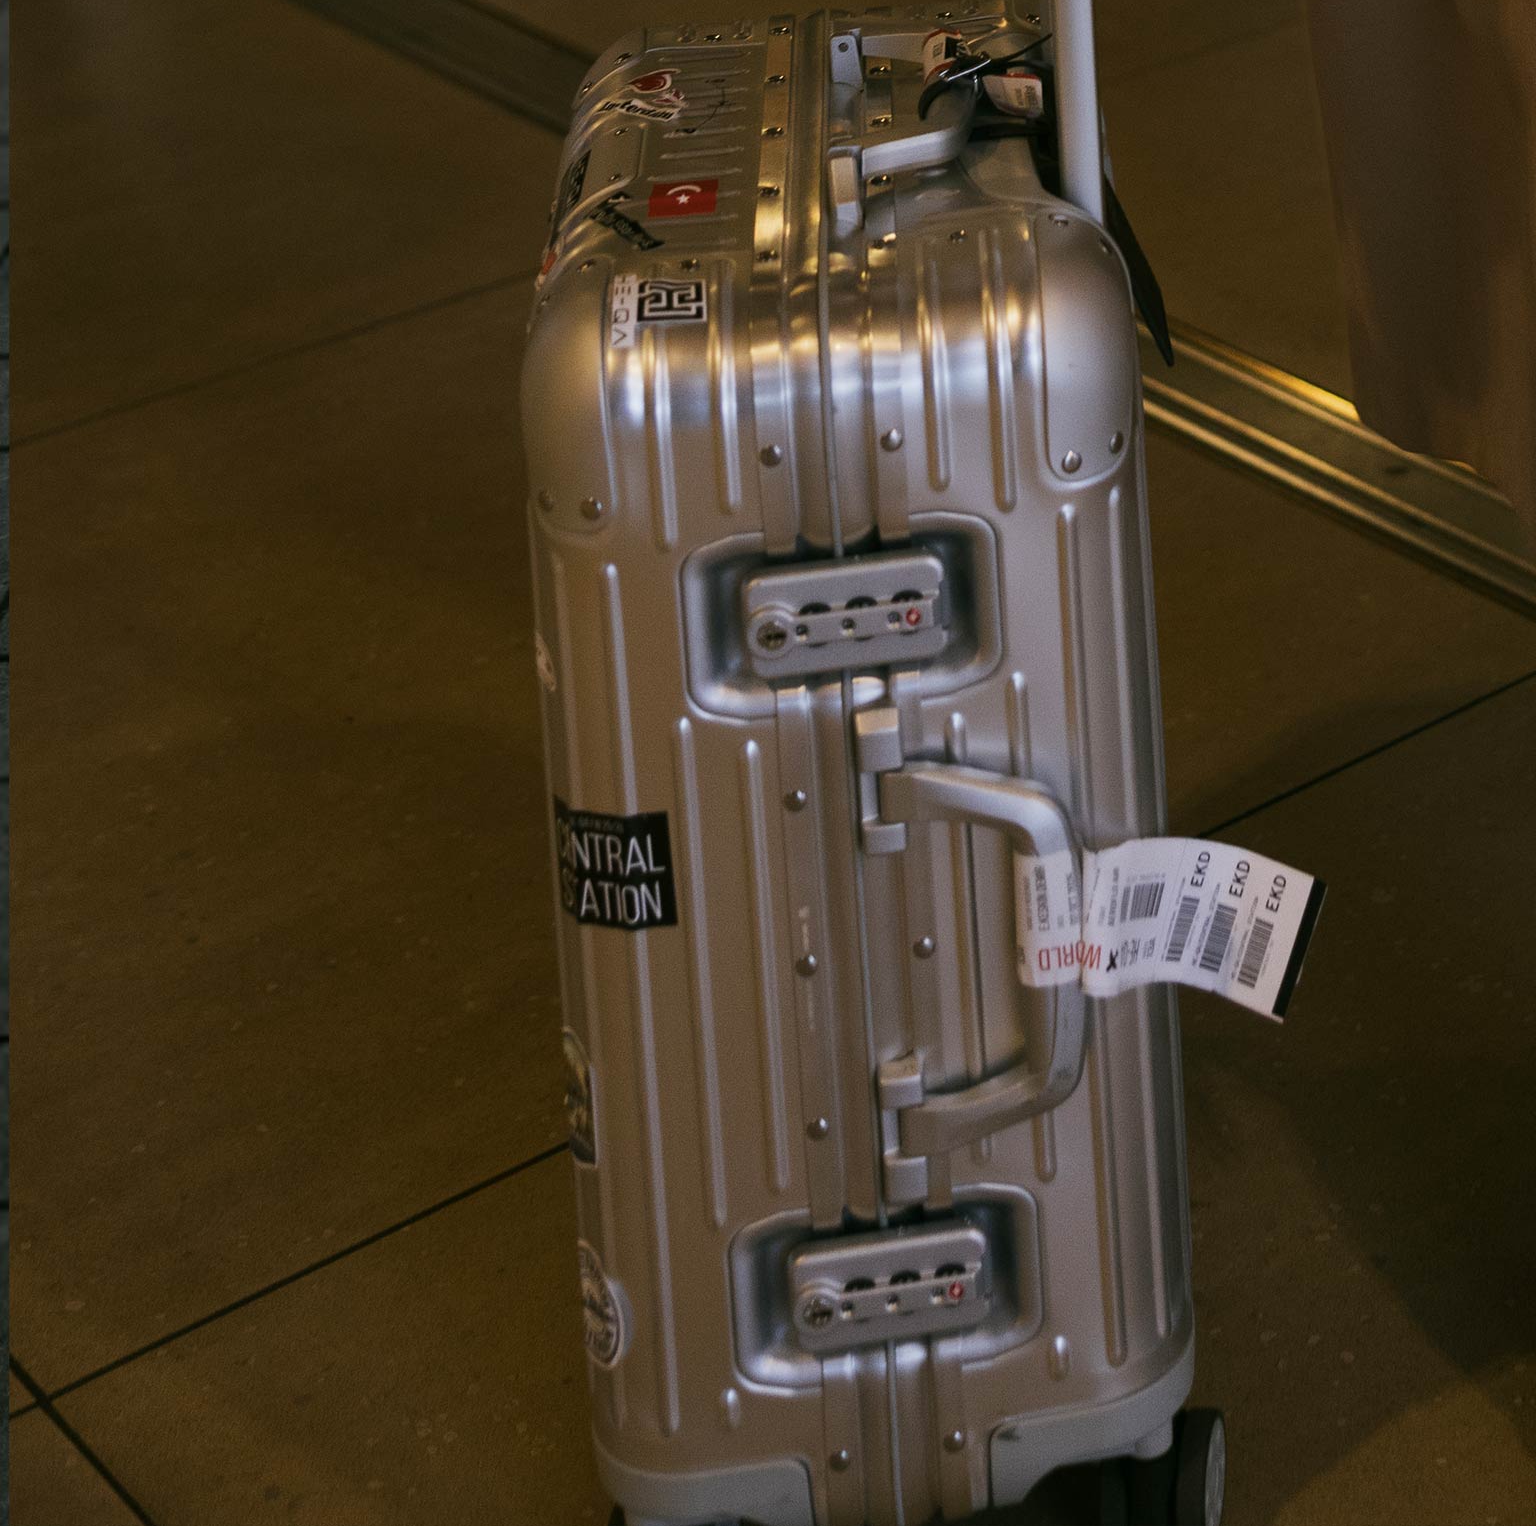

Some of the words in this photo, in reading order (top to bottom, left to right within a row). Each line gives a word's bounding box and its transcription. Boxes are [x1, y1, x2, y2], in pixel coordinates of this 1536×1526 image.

[557, 821, 666, 876] NTRAL
[1190, 850, 1211, 888] EKD
[1228, 859, 1251, 899] EKD
[1265, 874, 1287, 914] EKD
[1038, 939, 1102, 971] WORLD
